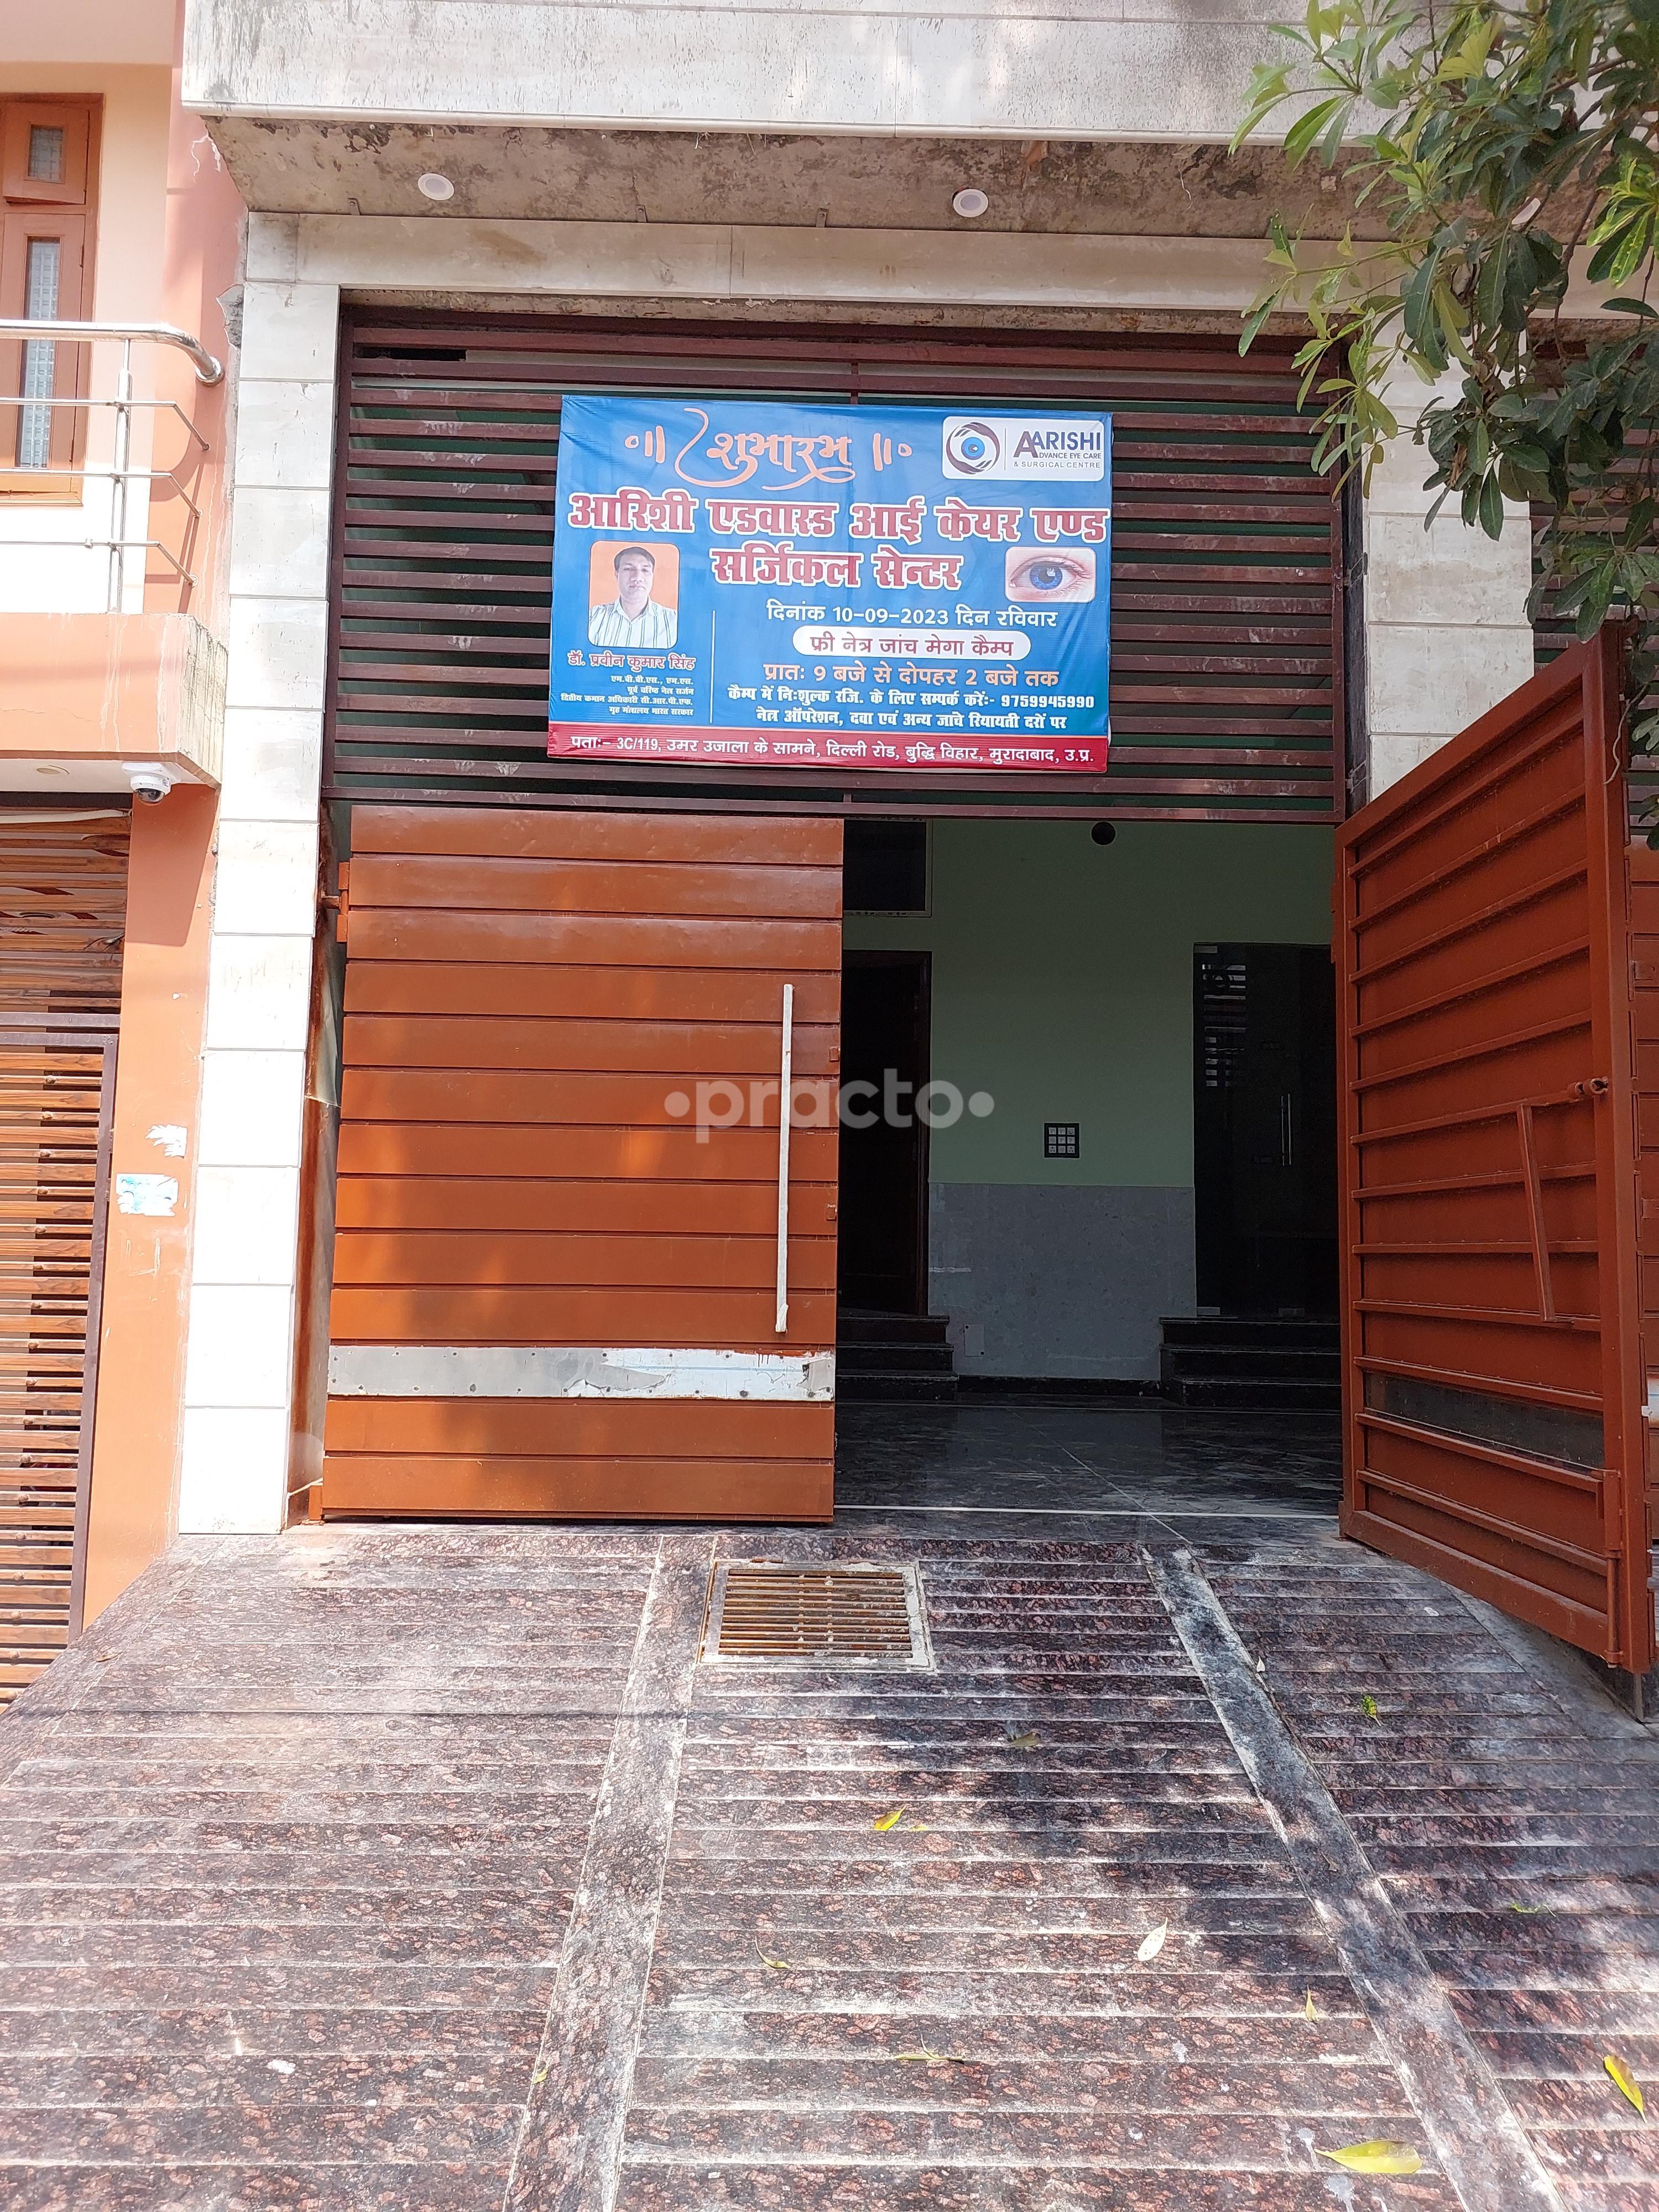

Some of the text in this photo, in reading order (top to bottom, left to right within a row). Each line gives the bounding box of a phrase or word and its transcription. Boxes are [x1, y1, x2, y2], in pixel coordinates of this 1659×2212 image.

[1013, 431, 1100, 458] AARISHI
[568, 487, 698, 533] आरिशी
[849, 495, 926, 545] आई
[933, 497, 1023, 541] केयर
[1030, 508, 1110, 542] एण्ड
[709, 540, 964, 591] सर्जिकल सेन्टर
[766, 598, 1058, 627] दिनांक 10-09-2023 दिन रविवार
[810, 631, 1014, 656] फ्री नेत्र जांच मेगा कैम्प
[589, 651, 625, 667] प्रवीन
[627, 655, 665, 672] कुमार
[668, 653, 696, 669] सिंह
[832, 660, 867, 682] बजे
[873, 660, 893, 684] से
[898, 661, 958, 685] दोपहर
[966, 670, 977, 685] 2
[984, 664, 1019, 686] बजे
[1024, 671, 1060, 687] तक
[608, 695, 638, 703] अधिकारी
[675, 687, 695, 695] सर्जन
[727, 684, 757, 700] कैम्प
[760, 685, 774, 701] में
[835, 688, 863, 703] रजि.
[869, 689, 884, 704] के
[889, 689, 916, 705] लिए
[920, 691, 959, 706] सम्पर्क
[1001, 695, 1094, 708] 9759945990
[756, 706, 779, 722] नेत्र
[784, 707, 843, 726] ऑपरेशन,
[849, 712, 874, 725] दवा
[877, 710, 899, 726] एवं
[903, 713, 933, 726] अन्य
[968, 712, 1020, 728] रियायती
[1024, 713, 1046, 729] दरों
[1050, 716, 1067, 729] पर
[617, 737, 661, 753] 3C/119,
[666, 739, 698, 752] उमर
[703, 740, 749, 753] उजाला
[754, 737, 768, 754] के
[773, 739, 821, 757] सामने,
[826, 740, 867, 758] दिल्ली
[873, 740, 899, 760] रोड,
[905, 742, 936, 763] बुद्धि
[940, 742, 983, 761] विहार,
[989, 748, 1059, 764] मुरादाबाद,
[1064, 749, 1093, 762] उ.प्र.
